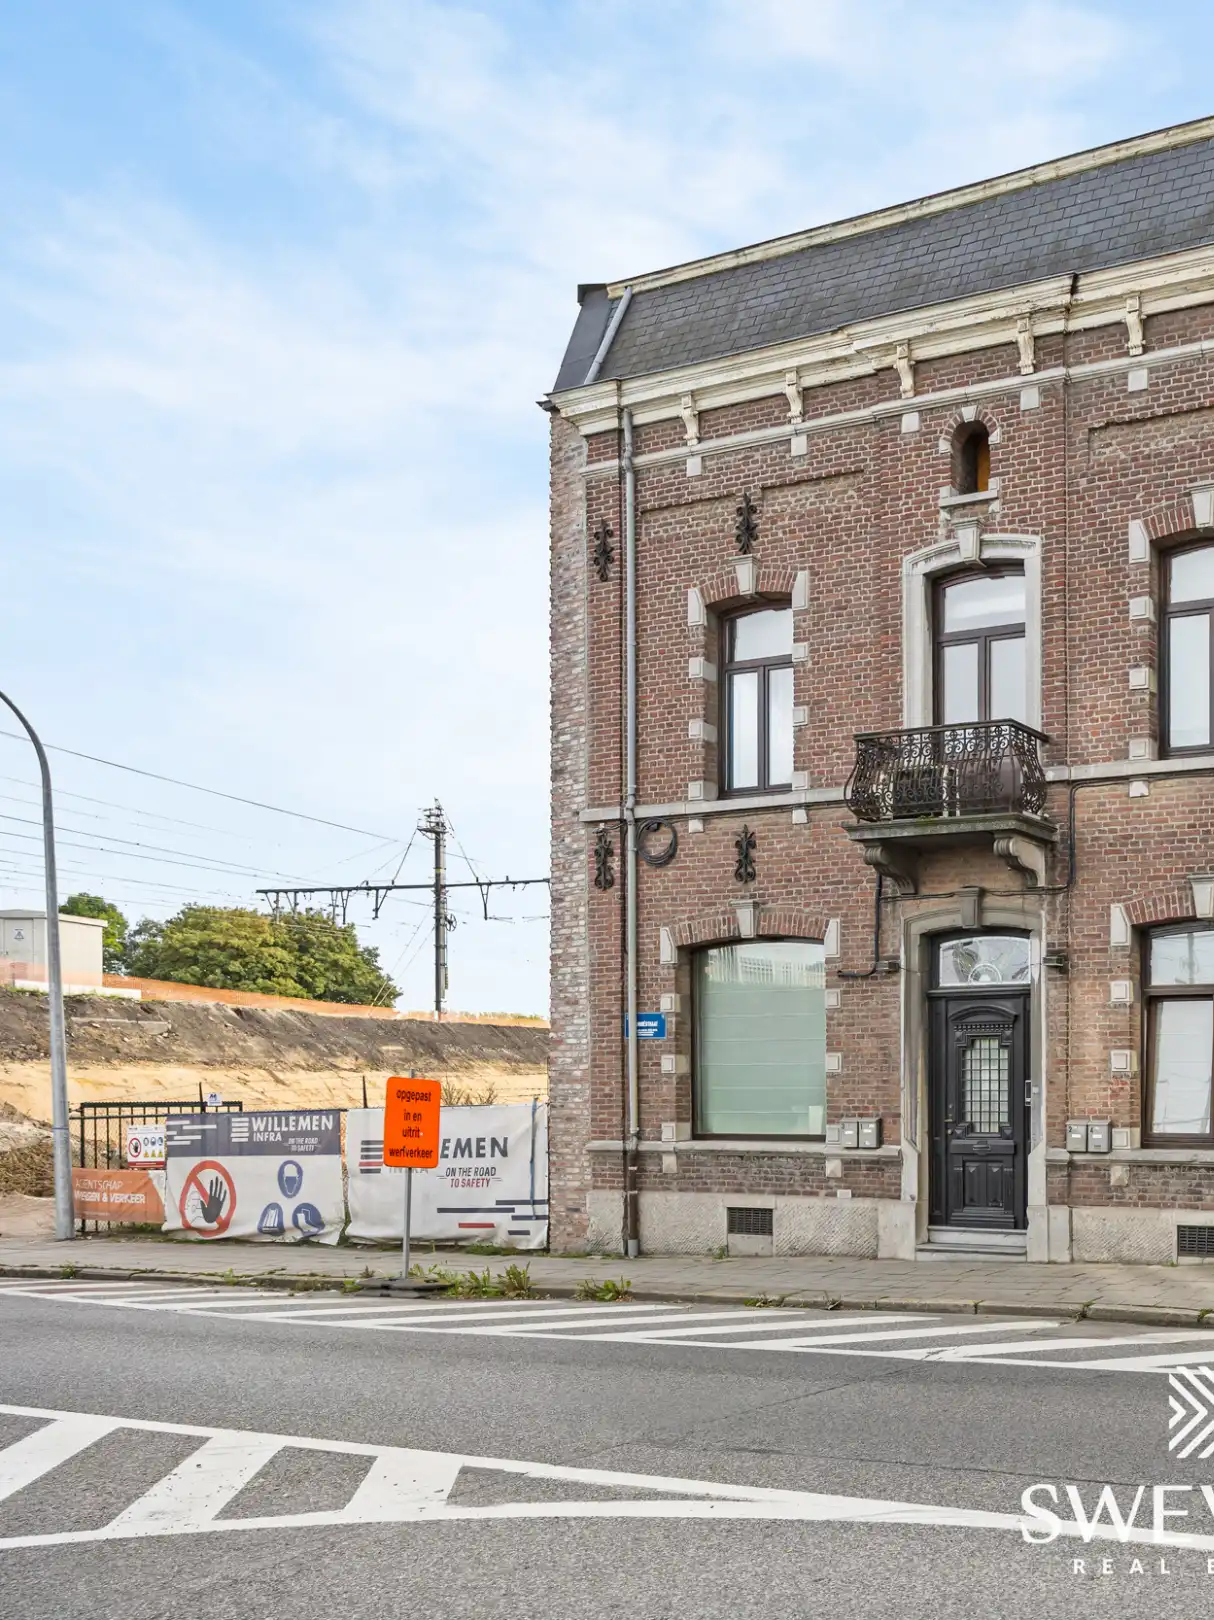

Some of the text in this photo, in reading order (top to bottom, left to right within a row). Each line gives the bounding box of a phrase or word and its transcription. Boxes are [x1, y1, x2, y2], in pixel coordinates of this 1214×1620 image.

[396, 1089, 432, 1103] opgepast
[403, 1109, 422, 1122] in en
[251, 1114, 334, 1132] WILLEMEN
[253, 1131, 282, 1142] INFRA
[402, 1126, 420, 1138] uitrit
[305, 1137, 319, 1145] ROAD
[388, 1145, 434, 1159] werfverkeer
[439, 1136, 509, 1159] EMEN
[445, 1166, 497, 1177] ON THE ROAD
[75, 1178, 124, 1191] AGENTSCHAP
[450, 1178, 491, 1188] TO SAFETY
[109, 1192, 146, 1204] VERKEER
